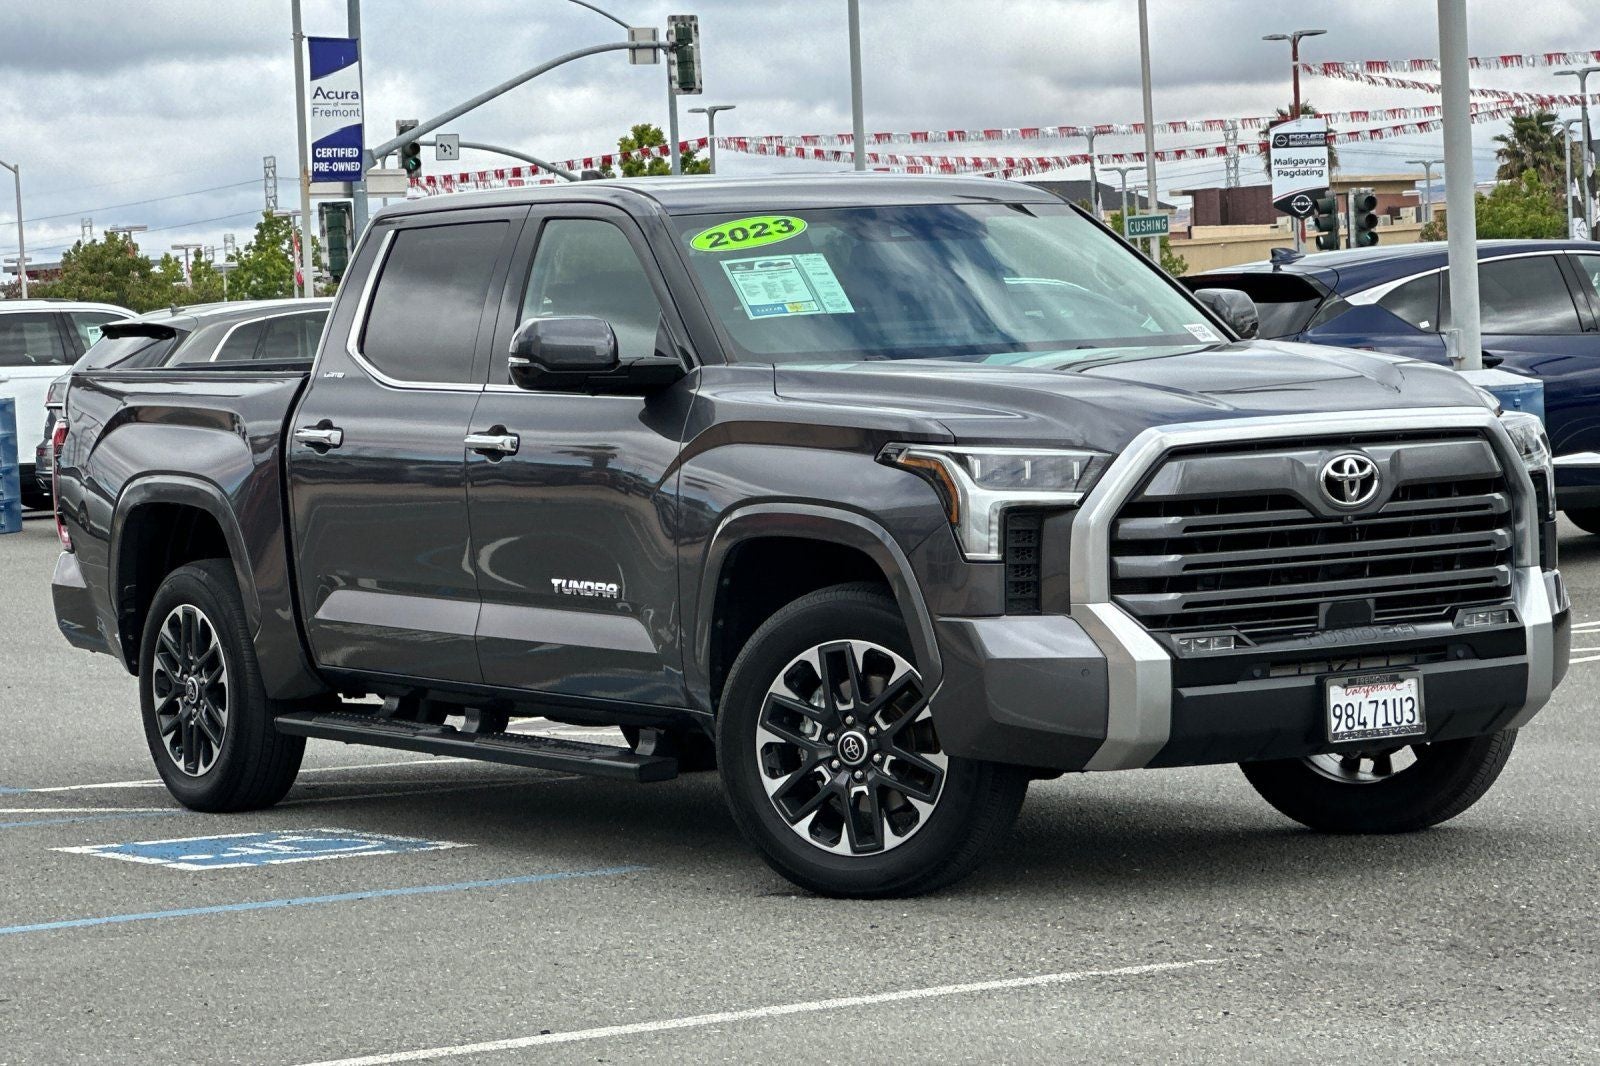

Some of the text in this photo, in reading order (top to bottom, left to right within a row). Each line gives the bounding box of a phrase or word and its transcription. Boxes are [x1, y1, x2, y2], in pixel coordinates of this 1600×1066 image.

[313, 86, 359, 100] Acura
[312, 107, 360, 118] Fremont
[315, 148, 359, 158] CERTIFIED
[313, 161, 361, 172] PRE-OWNED
[1273, 157, 1326, 166] Maligayang
[1277, 168, 1324, 178] Pagdating
[706, 218, 797, 248] 2023
[1129, 219, 1167, 233] CUSHING
[551, 578, 619, 599] TUNDRA
[1303, 624, 1417, 646] TUNDRA
[1356, 675, 1392, 684] FREMONT
[1344, 682, 1403, 699] California
[1332, 696, 1416, 732] 98471U3
